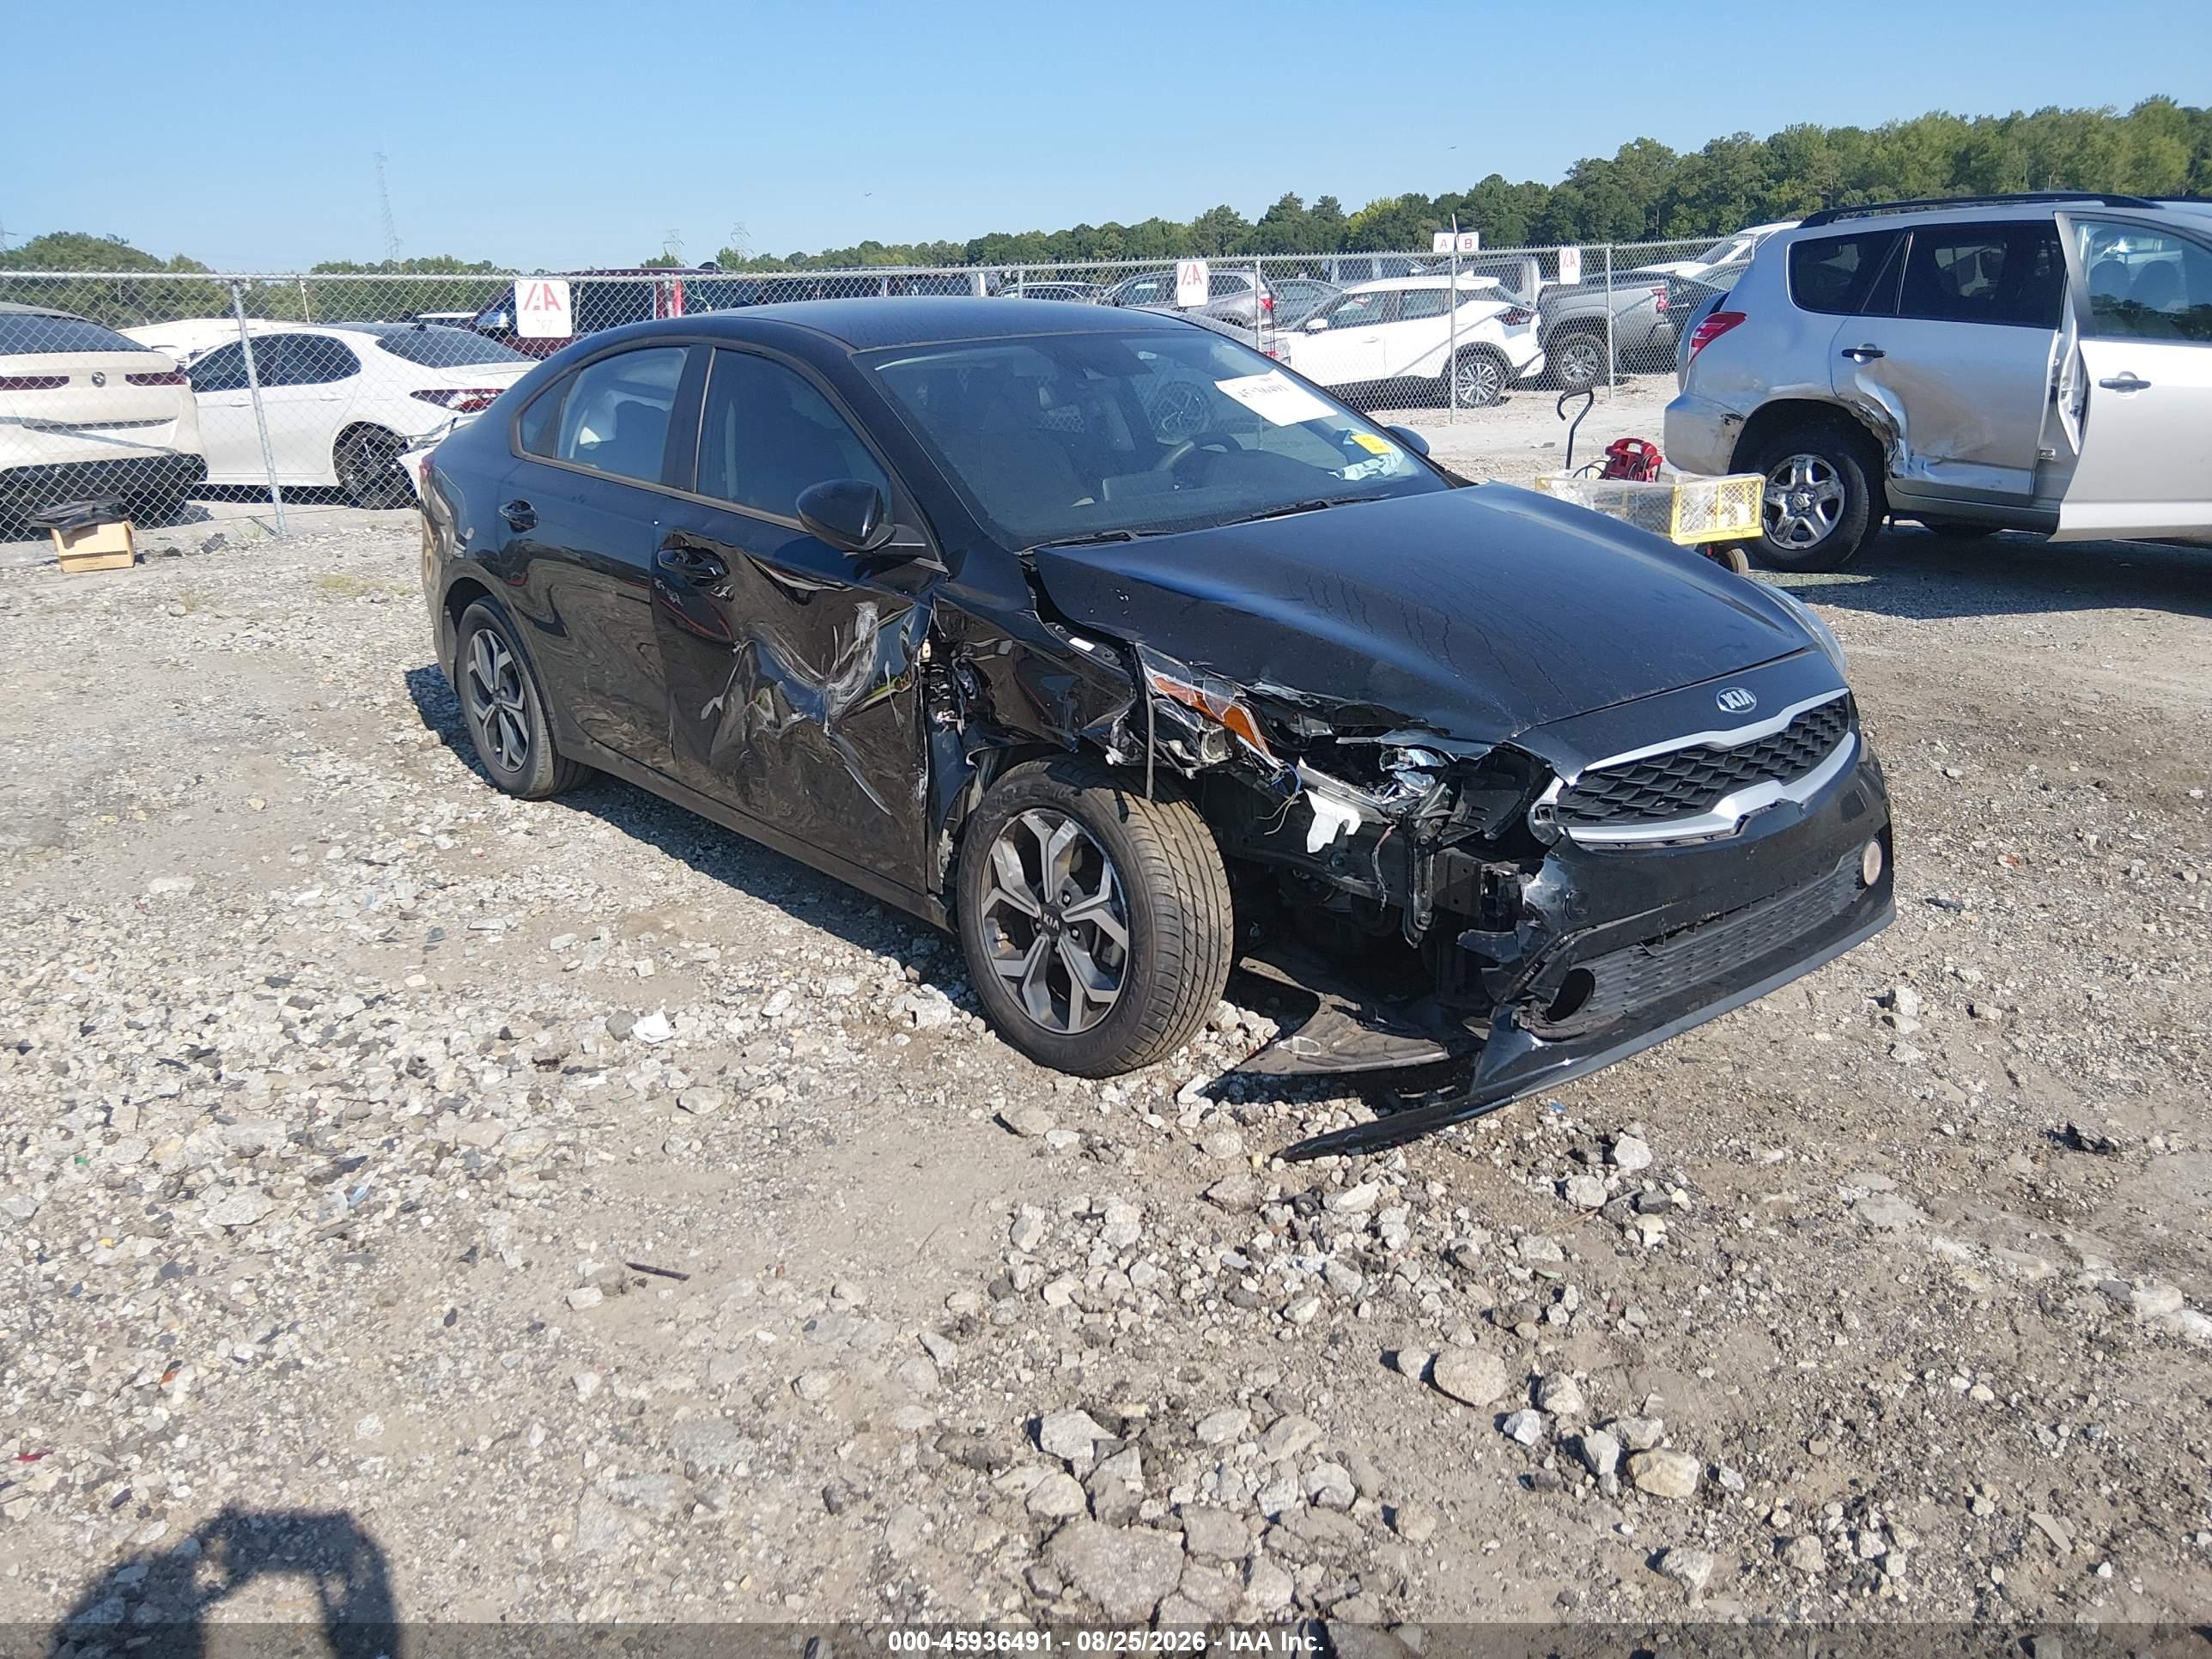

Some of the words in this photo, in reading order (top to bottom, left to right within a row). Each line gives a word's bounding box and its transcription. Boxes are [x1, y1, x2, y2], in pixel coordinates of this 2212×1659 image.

[1439, 239, 1448, 249] A
[1464, 238, 1473, 249] B
[1720, 690, 1754, 708] KIA
[1042, 912, 1060, 931] KIA
